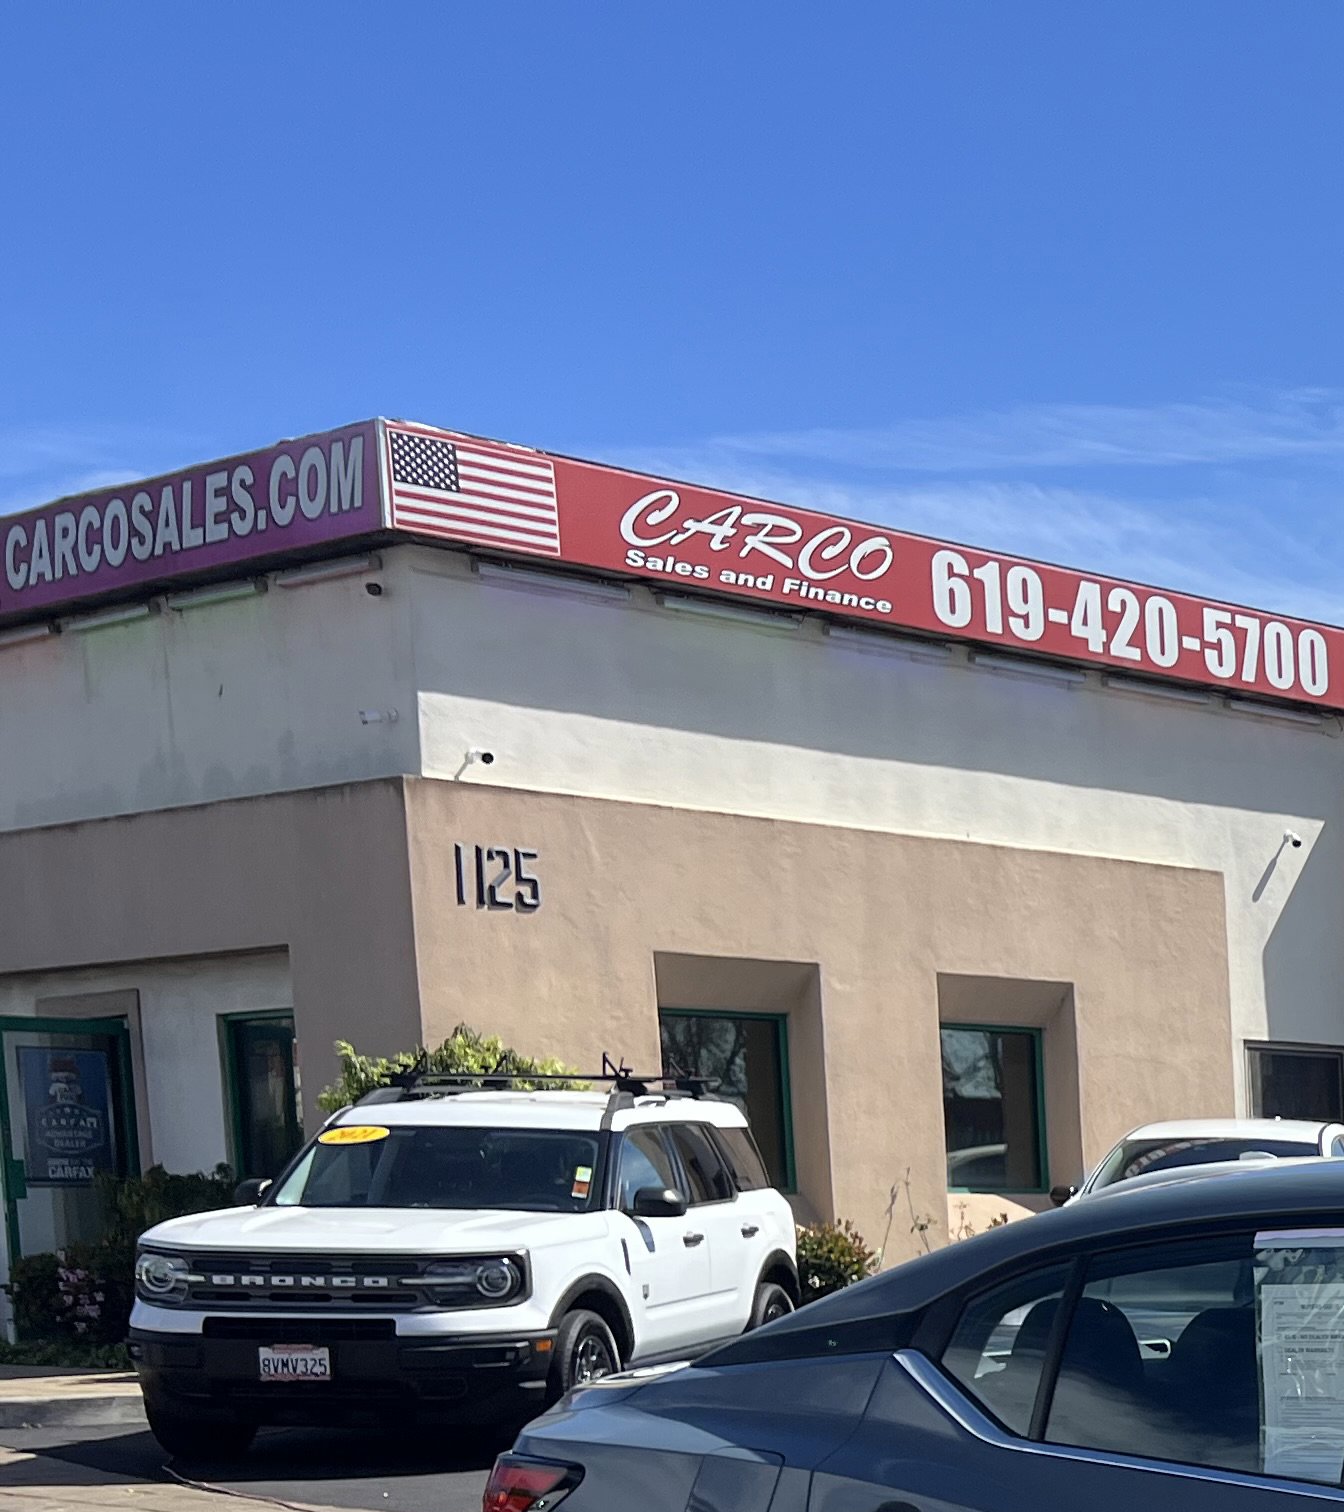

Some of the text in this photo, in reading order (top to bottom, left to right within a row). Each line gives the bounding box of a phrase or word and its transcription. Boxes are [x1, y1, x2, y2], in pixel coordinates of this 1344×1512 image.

[4, 434, 364, 591] CARCOSALES.COM
[620, 490, 893, 580] CARCO
[625, 549, 893, 614] Sales and Finance
[931, 549, 1328, 697] 619-420-5700
[454, 842, 540, 913] 1125
[212, 1275, 388, 1287] BRONCO
[262, 1358, 327, 1378] 8VMV325
